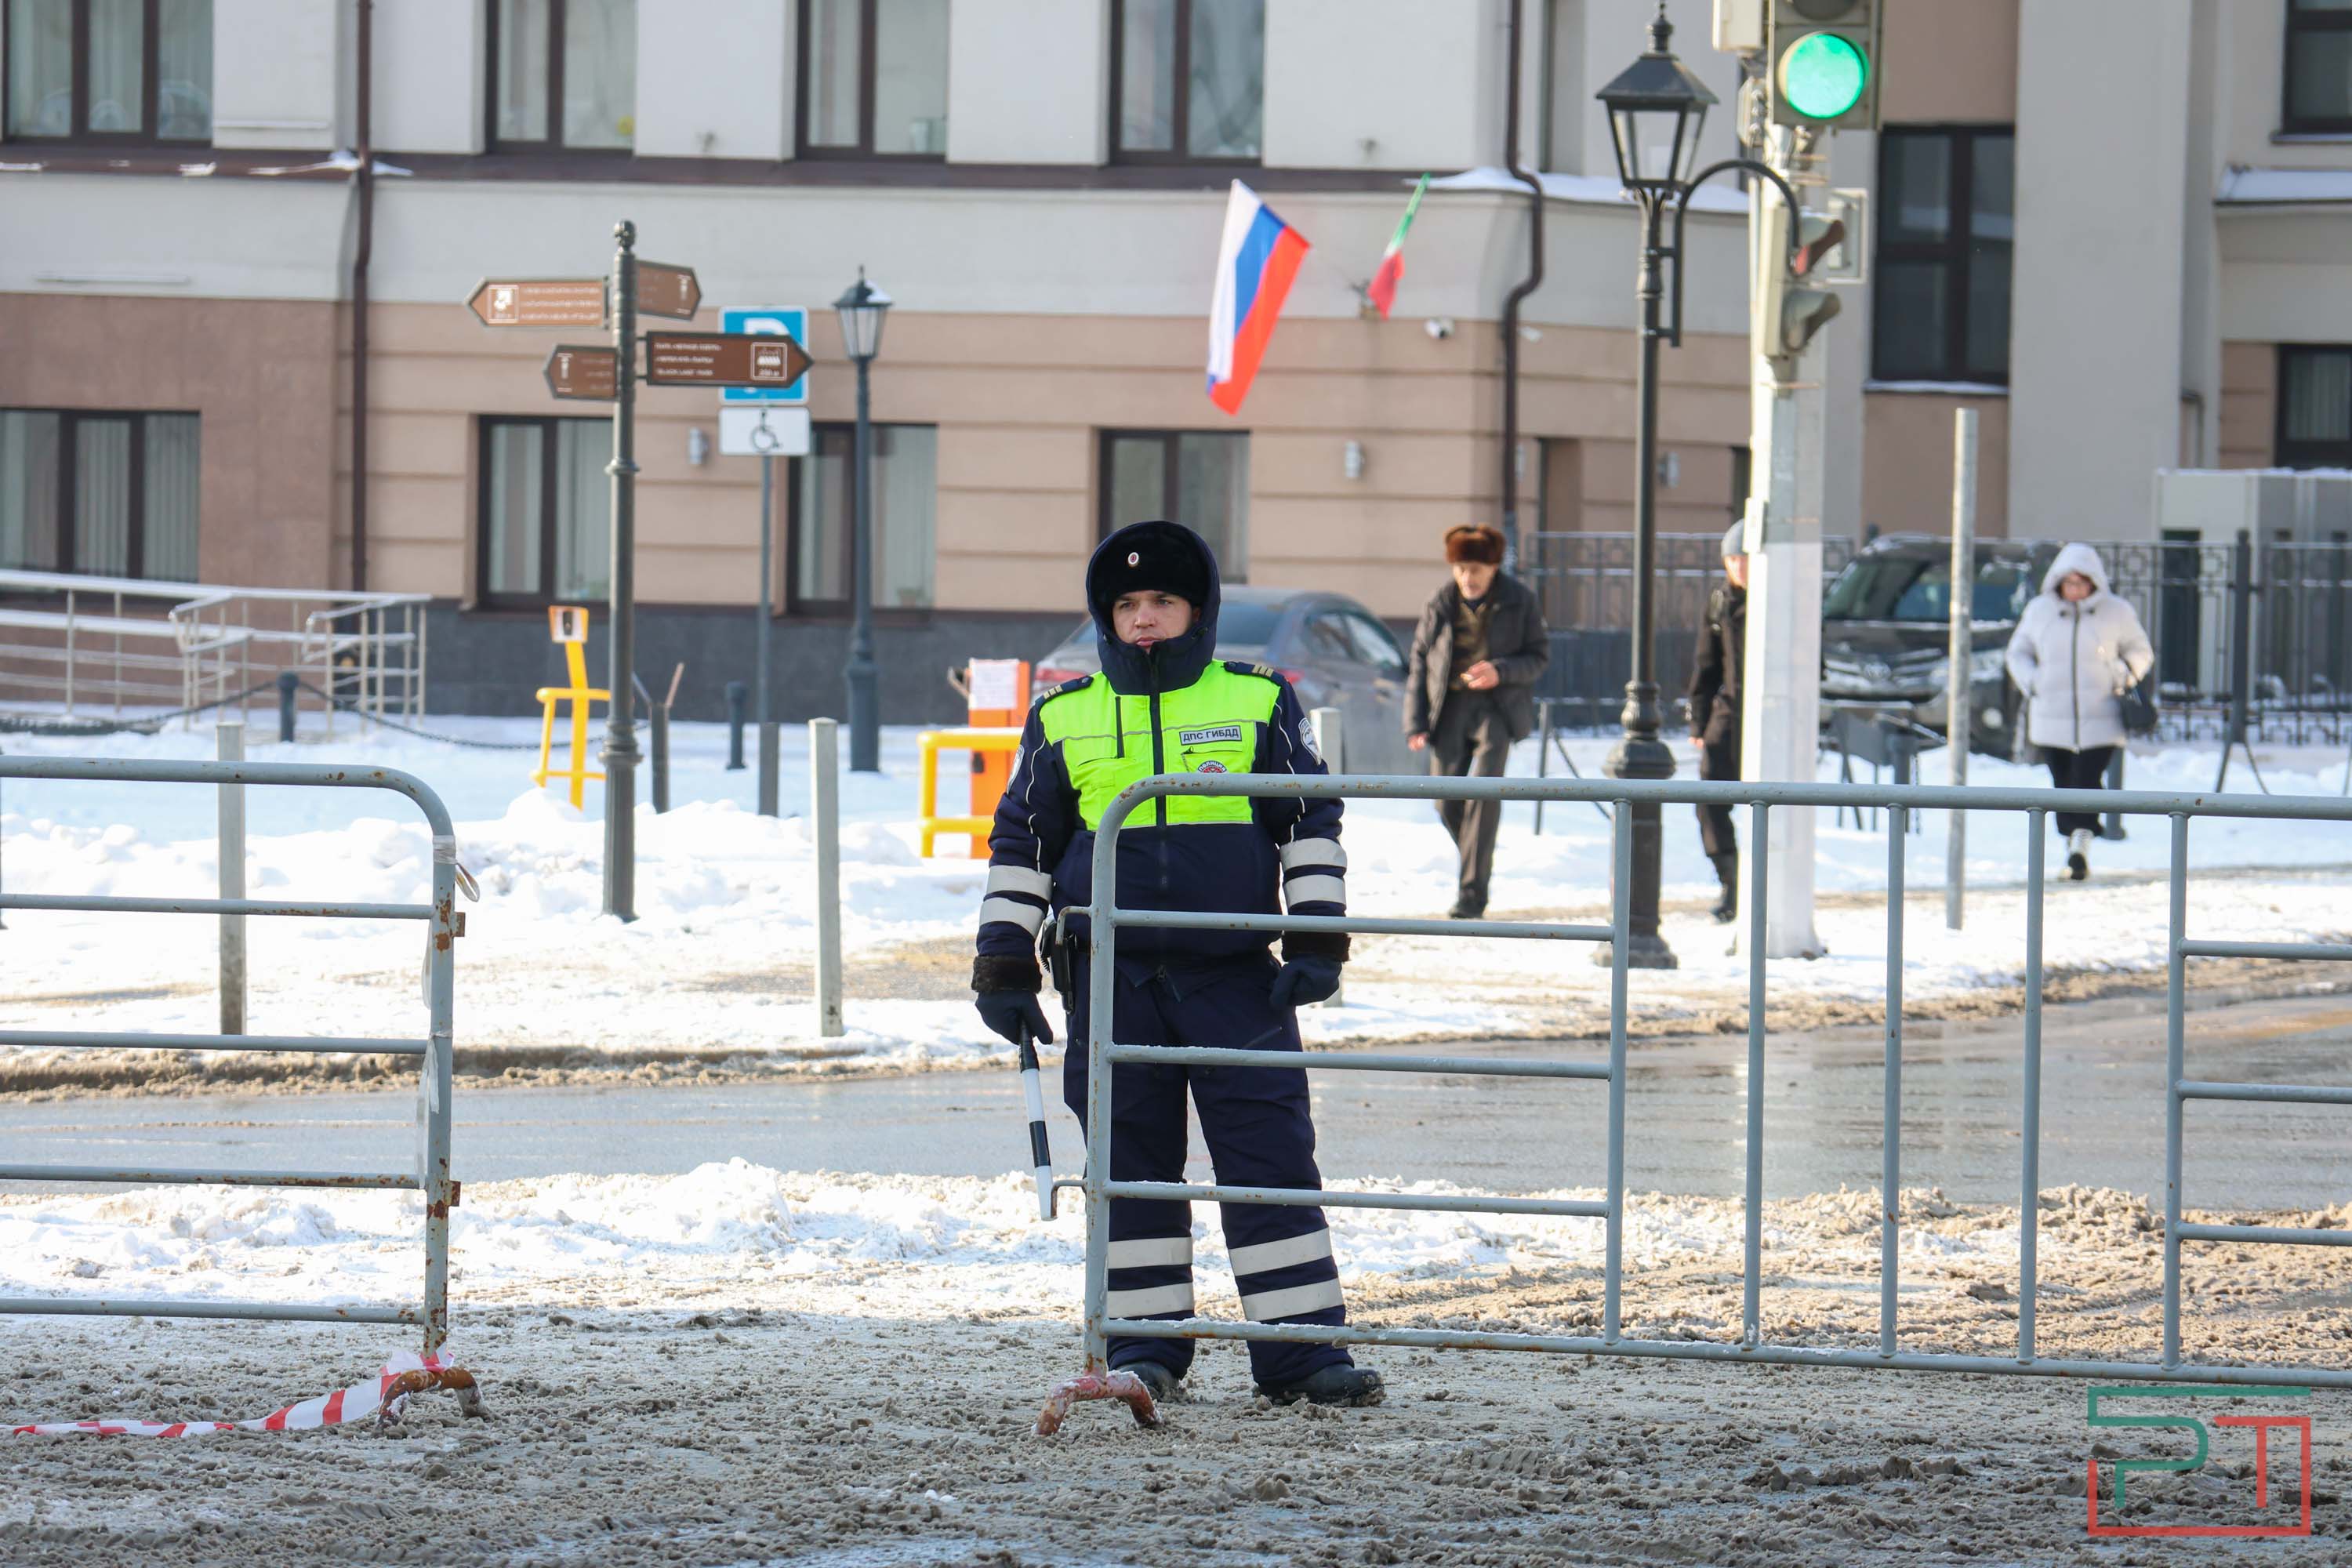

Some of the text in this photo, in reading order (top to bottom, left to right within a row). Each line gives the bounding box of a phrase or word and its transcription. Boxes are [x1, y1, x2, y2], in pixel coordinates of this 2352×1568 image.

[1183, 728, 1240, 742] ДПС ГИБДД
[1198, 760, 1225, 772] ПОЛИЦИЯ
